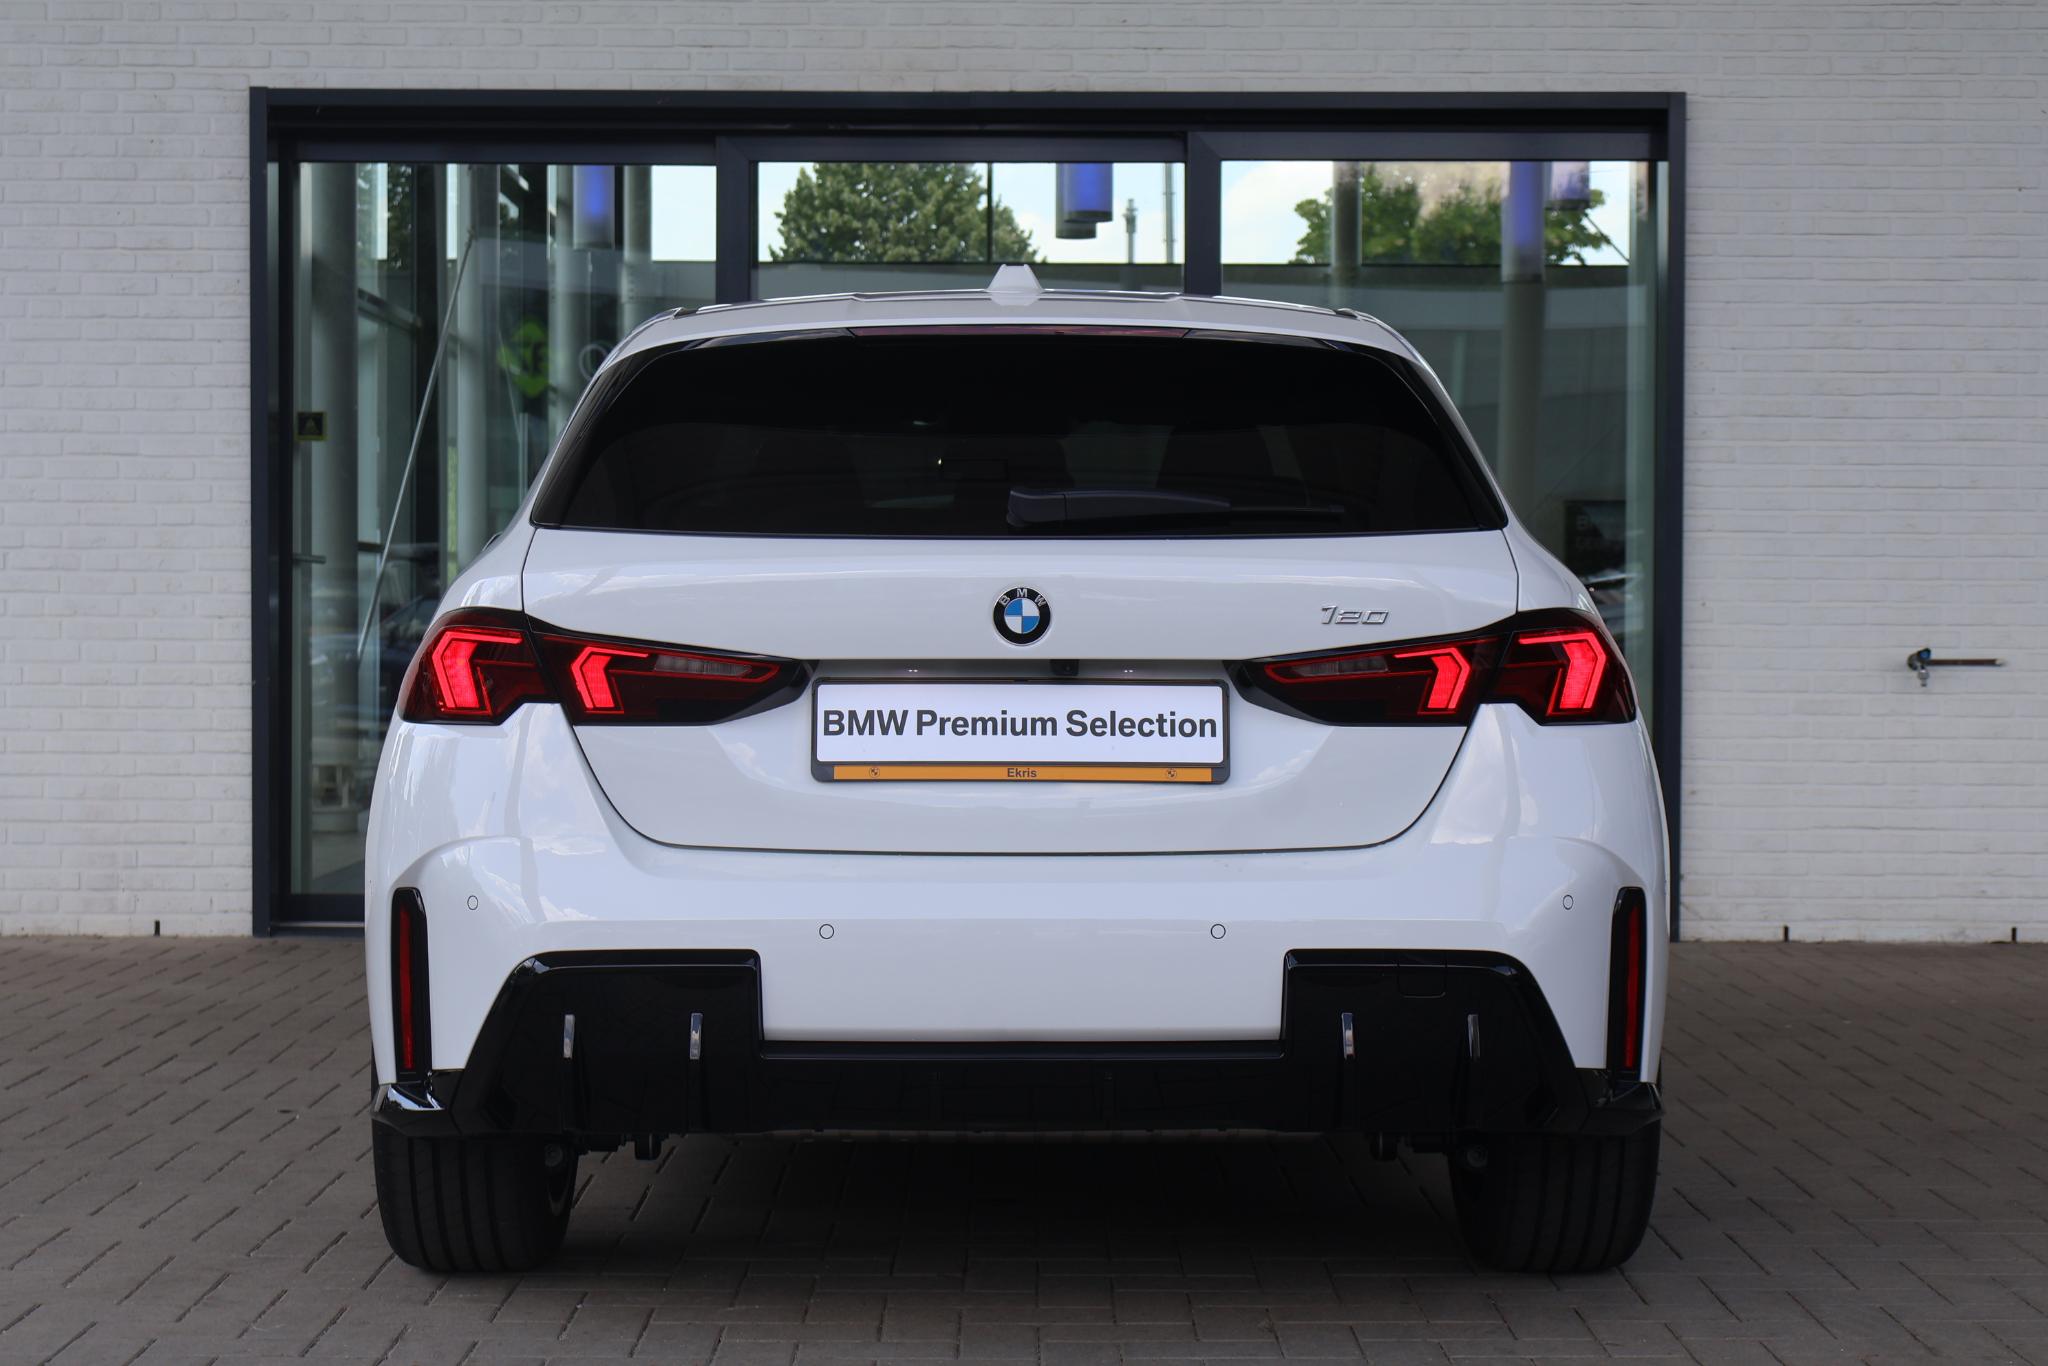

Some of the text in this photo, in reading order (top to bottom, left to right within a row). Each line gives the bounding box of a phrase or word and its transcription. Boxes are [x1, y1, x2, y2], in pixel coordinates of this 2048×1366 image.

[998, 587, 1047, 607] BMW
[1320, 605, 1390, 625] 120
[823, 709, 1218, 738] BMW Premium Selection
[1007, 767, 1037, 778] Ekris
